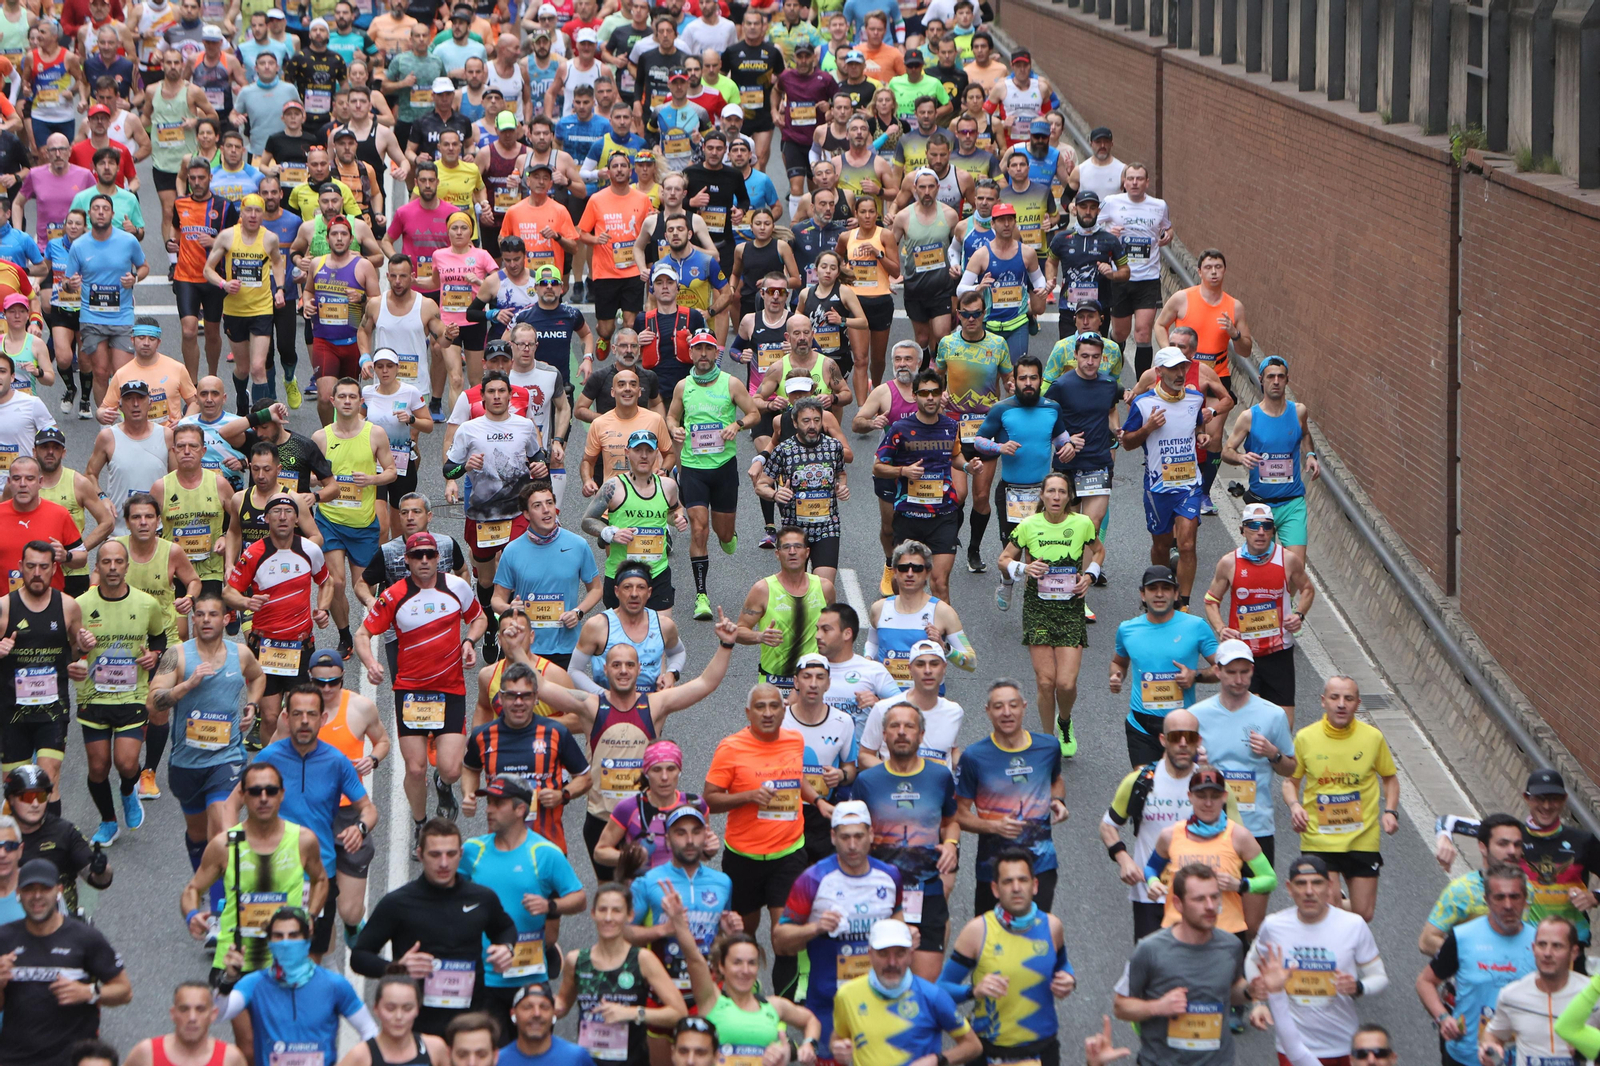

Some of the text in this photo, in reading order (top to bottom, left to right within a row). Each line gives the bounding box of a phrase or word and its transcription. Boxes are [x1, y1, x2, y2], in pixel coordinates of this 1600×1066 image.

[603, 213, 623, 221] RUN
[921, 243, 940, 251] ZURICH
[232, 252, 264, 260] BEDFORD
[537, 331, 567, 339] RANCE
[699, 422, 722, 430] ZURICH
[1173, 455, 1194, 463] ZURICH
[807, 491, 829, 499] ZURICH
[184, 527, 208, 535] ZURICH
[1050, 566, 1073, 574] ZURICH
[1249, 602, 1272, 613] ZURICH
[109, 656, 135, 665] ZURICH
[272, 652, 287, 660] 4422
[29, 666, 54, 676] ZURICH
[202, 711, 228, 722] ZURICH
[920, 749, 944, 760] ZURICH
[615, 759, 642, 768] ZURICH
[615, 773, 631, 781] 4335
[1225, 770, 1252, 780] ZURICH
[775, 779, 799, 789] ZURICH
[1175, 798, 1194, 809] yo
[253, 893, 284, 903] ZURICH
[442, 960, 473, 972] ZURICH
[1301, 960, 1333, 971] ZURICH
